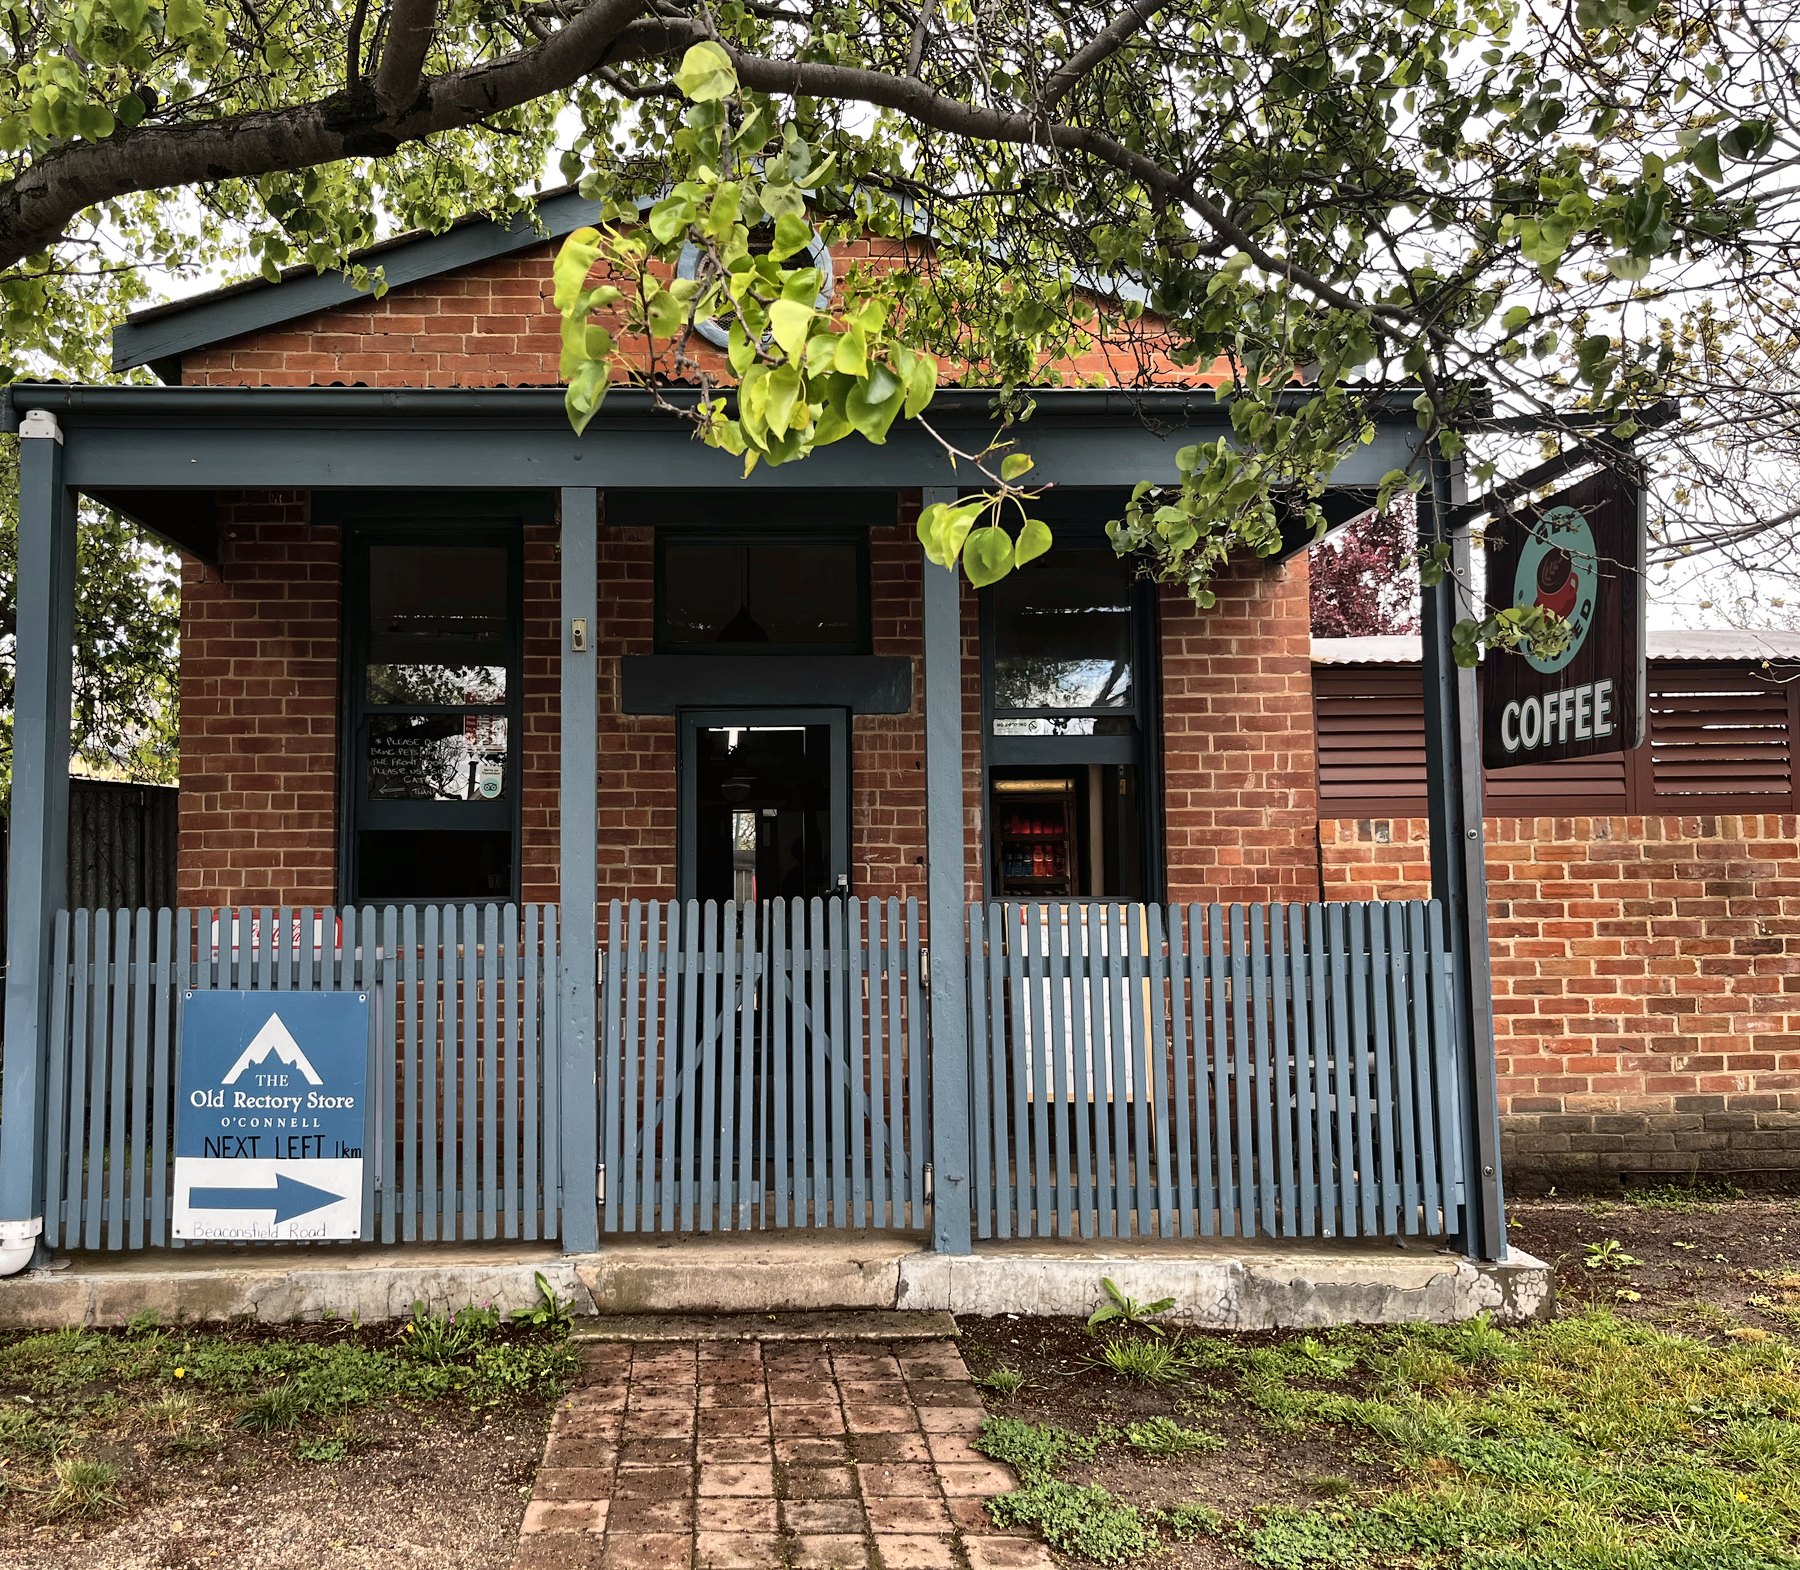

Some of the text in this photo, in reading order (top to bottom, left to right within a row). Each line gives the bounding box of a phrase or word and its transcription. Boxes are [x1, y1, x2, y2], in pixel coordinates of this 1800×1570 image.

[1501, 677, 1613, 753] COFFEE
[387, 737, 420, 746] PLEASE
[398, 748, 419, 756] PETS
[391, 758, 417, 766] FRONT
[372, 767, 405, 775] PLEASE
[255, 1074, 289, 1087] THE
[190, 1089, 354, 1113] Old Rectory Store
[221, 1117, 321, 1128] O'CONNELL
[204, 1135, 261, 1159] NEXT
[275, 1134, 326, 1160] LEFT
[193, 1222, 327, 1239] Beaconsfield Road
